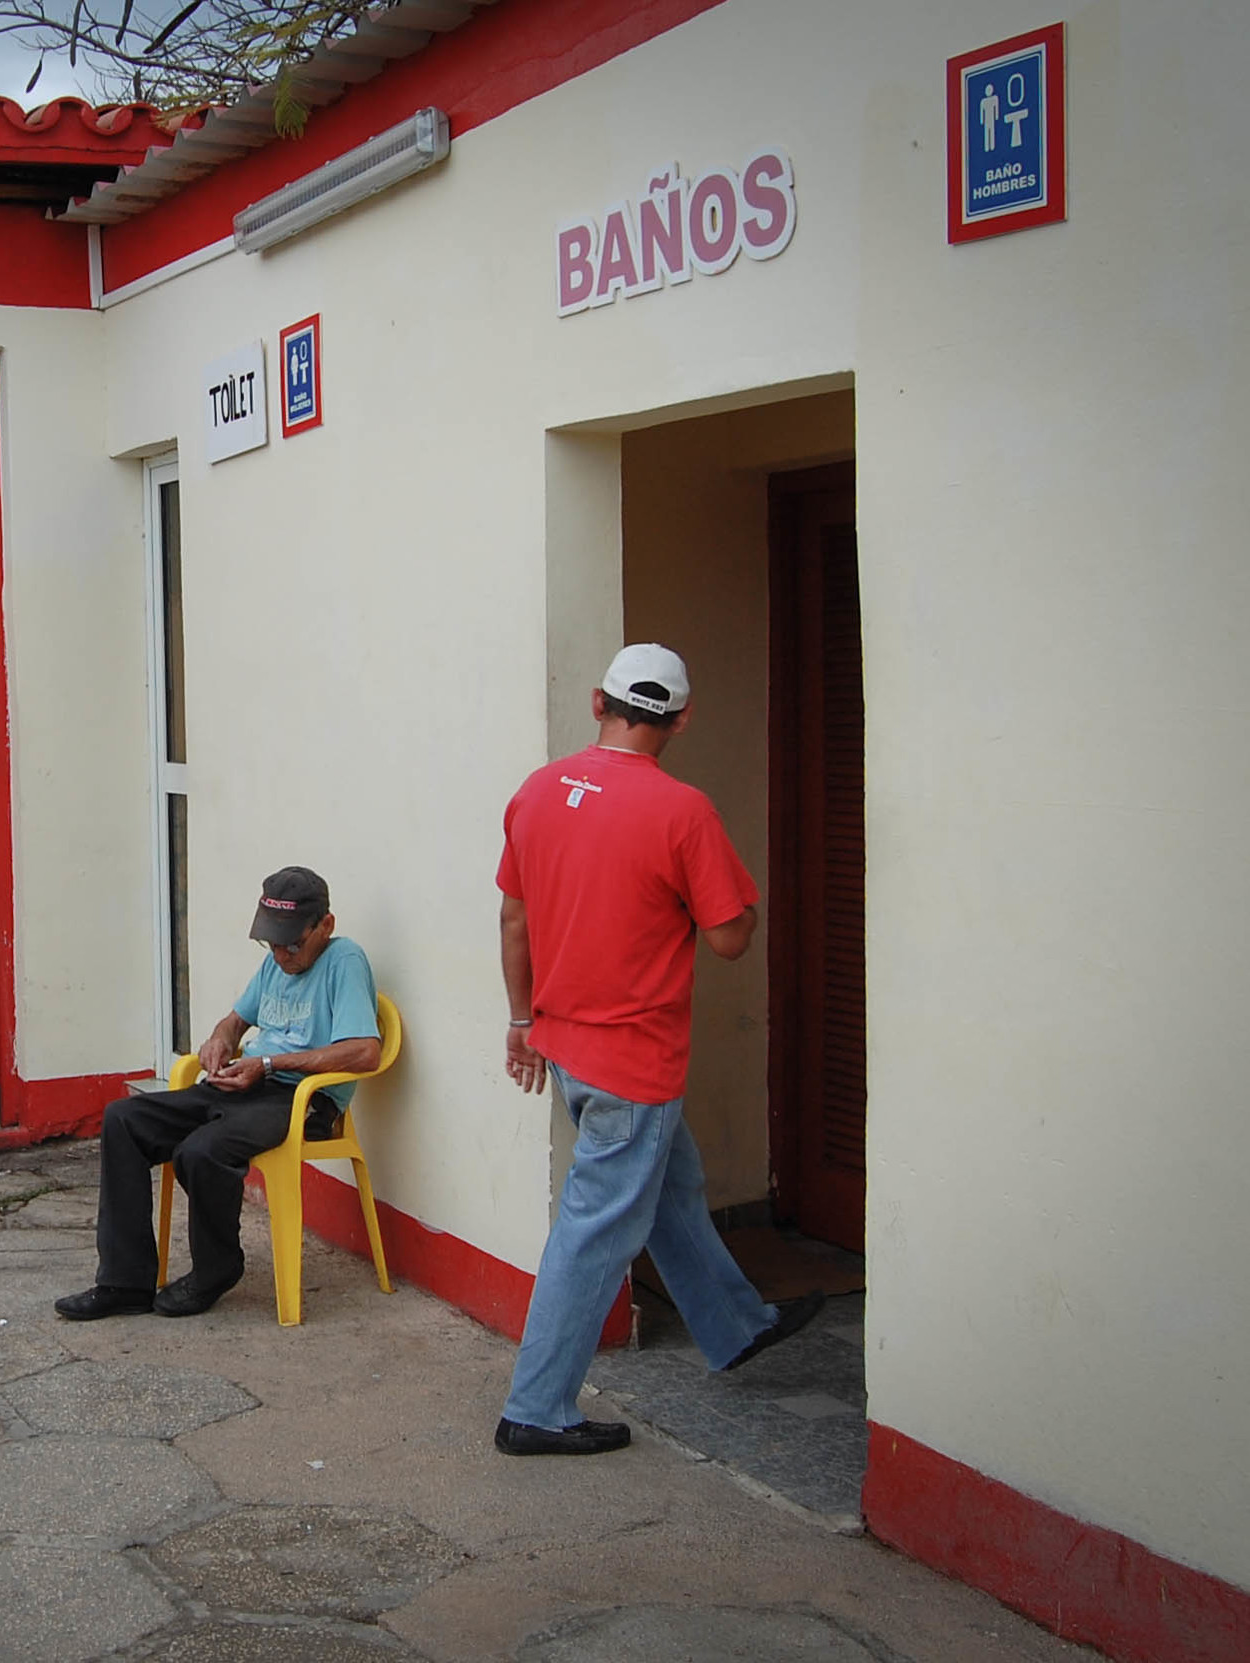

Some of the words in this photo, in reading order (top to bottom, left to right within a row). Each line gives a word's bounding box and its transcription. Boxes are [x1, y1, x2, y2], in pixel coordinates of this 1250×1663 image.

[986, 163, 1022, 182] BAÑO
[973, 174, 1036, 200] HOMBRES
[559, 154, 788, 308] BAÑOS
